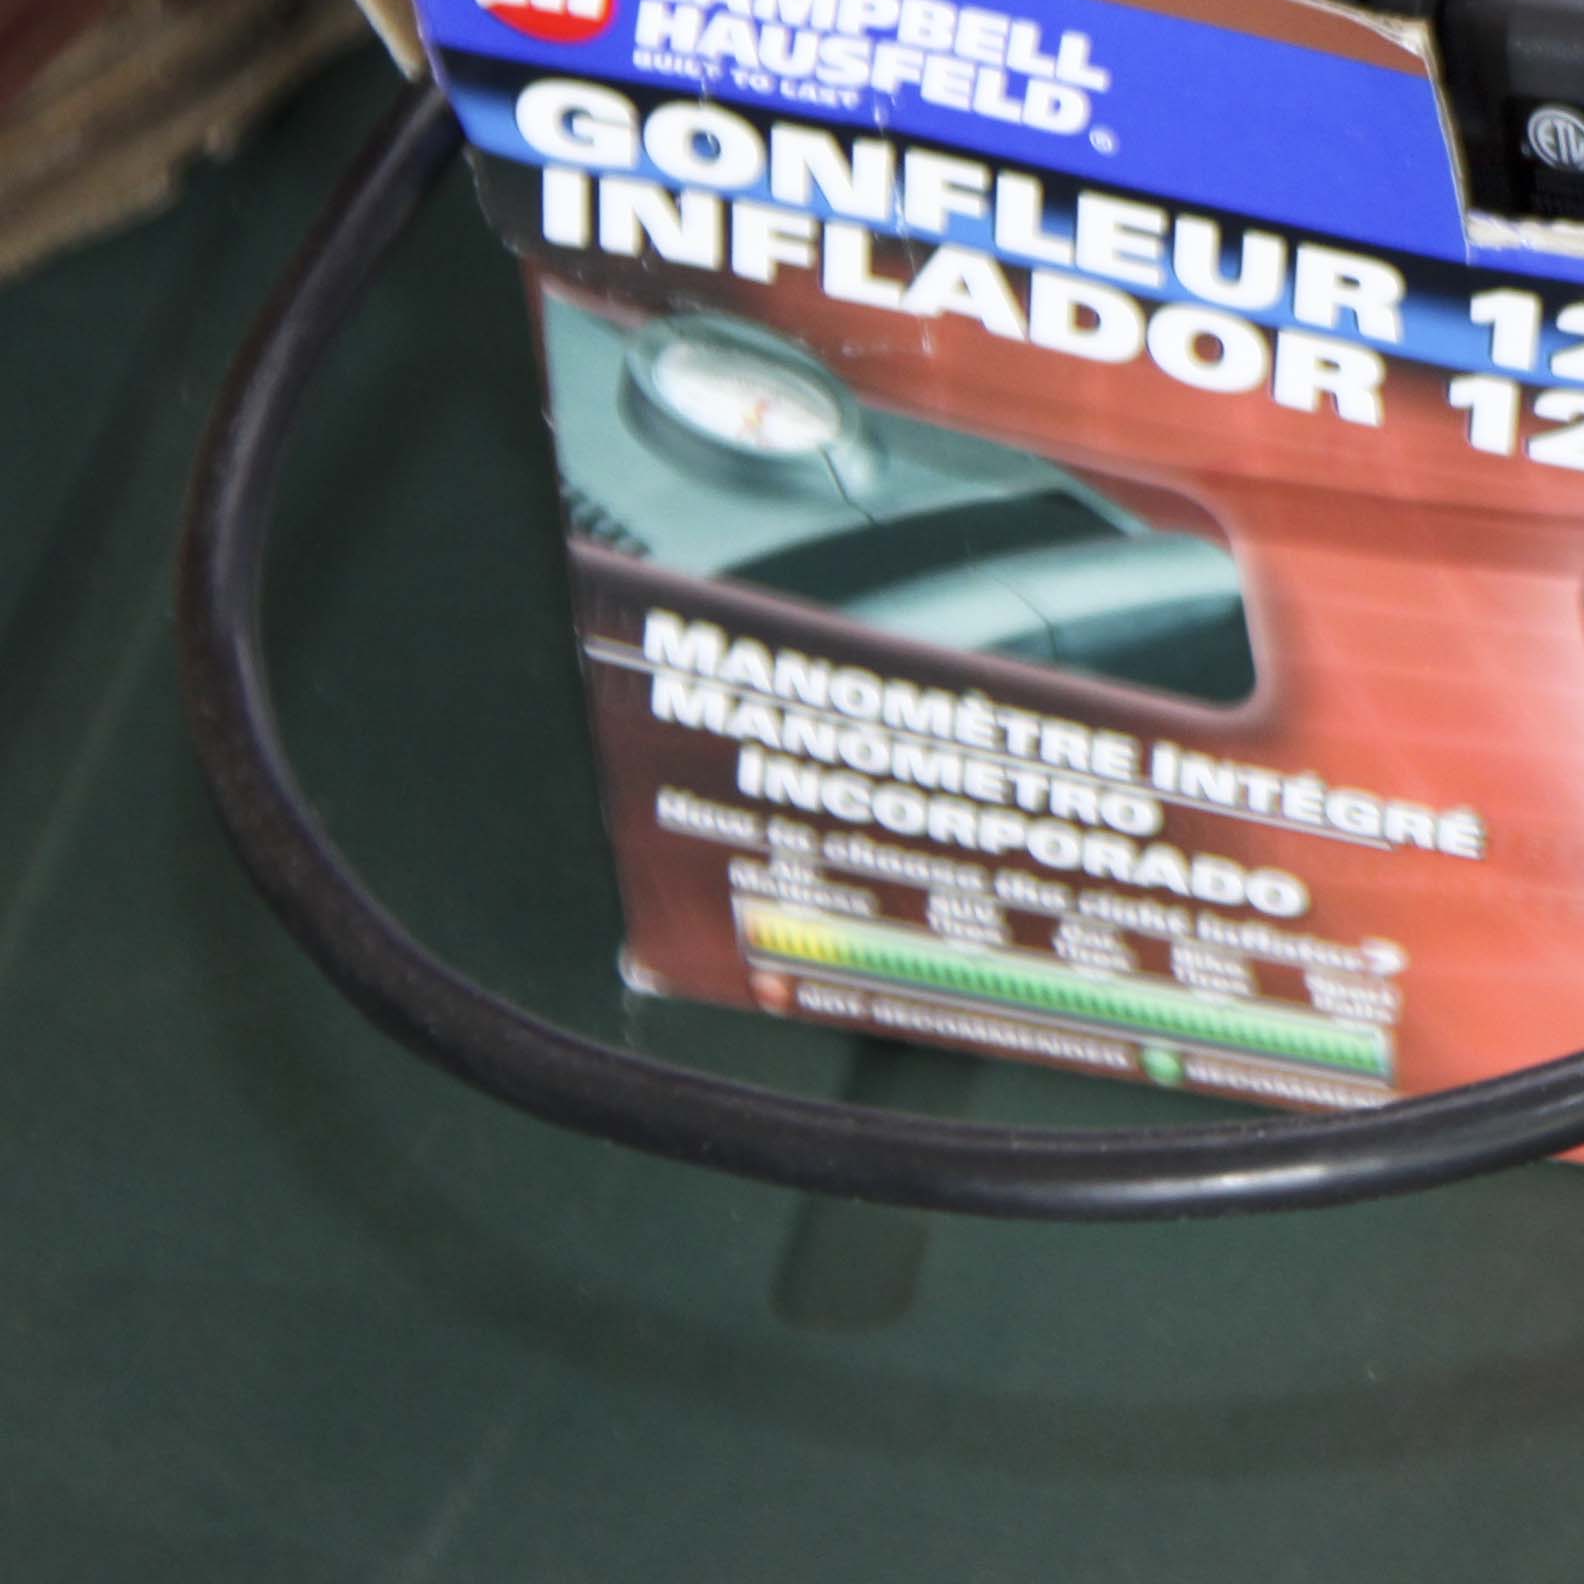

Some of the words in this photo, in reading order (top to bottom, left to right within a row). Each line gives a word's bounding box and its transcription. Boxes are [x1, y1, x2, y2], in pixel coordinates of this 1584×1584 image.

[632, 0, 1094, 136] HAUSFELD
[632, 49, 724, 81] BUILT
[729, 70, 776, 95] TO
[778, 76, 861, 110] LAST
[514, 78, 1405, 344] GONFLEUR
[540, 168, 1385, 427] INFLADOR
[643, 607, 1142, 781] MANOMÈTRE
[1151, 739, 1487, 860] INTÉGRÉ
[737, 741, 1311, 918] INCORPORADO
